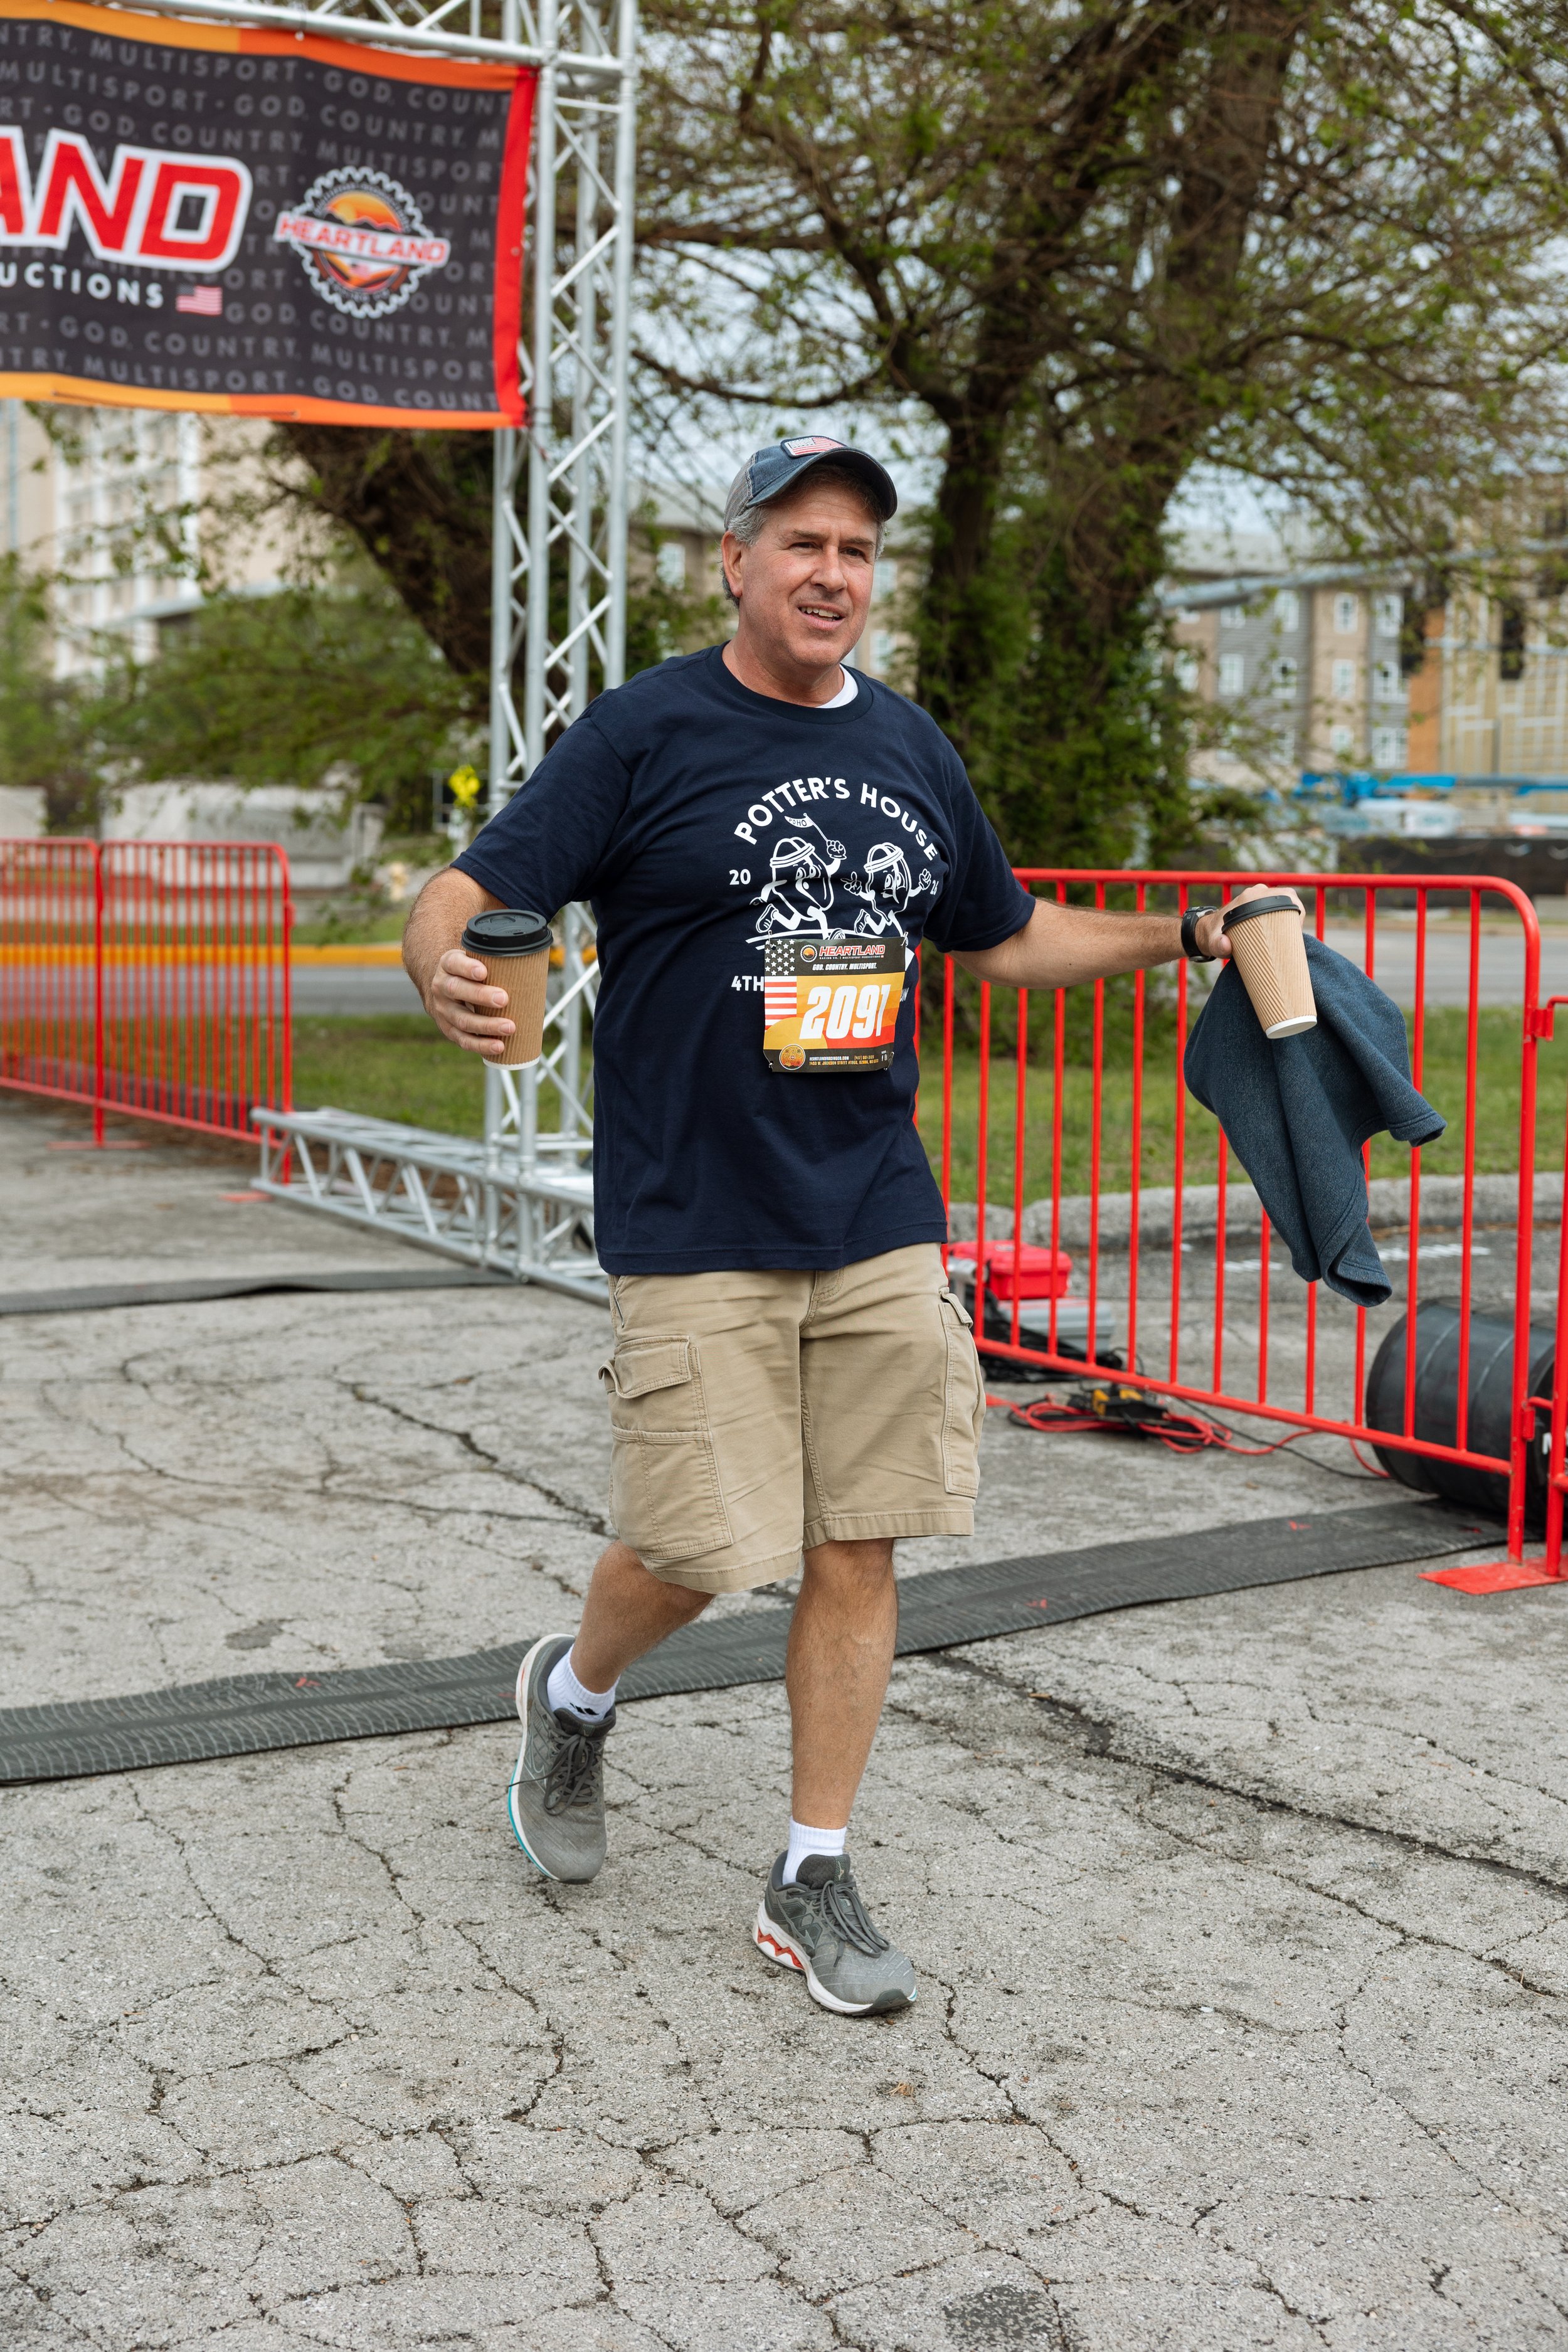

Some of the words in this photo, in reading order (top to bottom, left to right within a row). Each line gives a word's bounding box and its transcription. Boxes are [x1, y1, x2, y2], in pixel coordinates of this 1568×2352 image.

[89, 36, 296, 82] MULTISPORT
[0, 59, 208, 113] MULTISPORT
[315, 137, 504, 183] MULTISPOR
[415, 190, 501, 216] OUNT
[278, 216, 448, 264] HEARTLAND
[0, 261, 164, 309] UCTIONS
[409, 290, 495, 316] OUNT
[0, 346, 72, 373] TRY.
[83, 353, 287, 392] MULTISPORT
[734, 776, 850, 845] POTTER'S
[860, 783, 938, 861] HOUSE
[789, 818, 807, 827] POHO
[729, 869, 751, 885] 20
[818, 945, 886, 956] HEARTLAND
[731, 976, 764, 991] 4TH
[799, 984, 891, 1040] 2091
